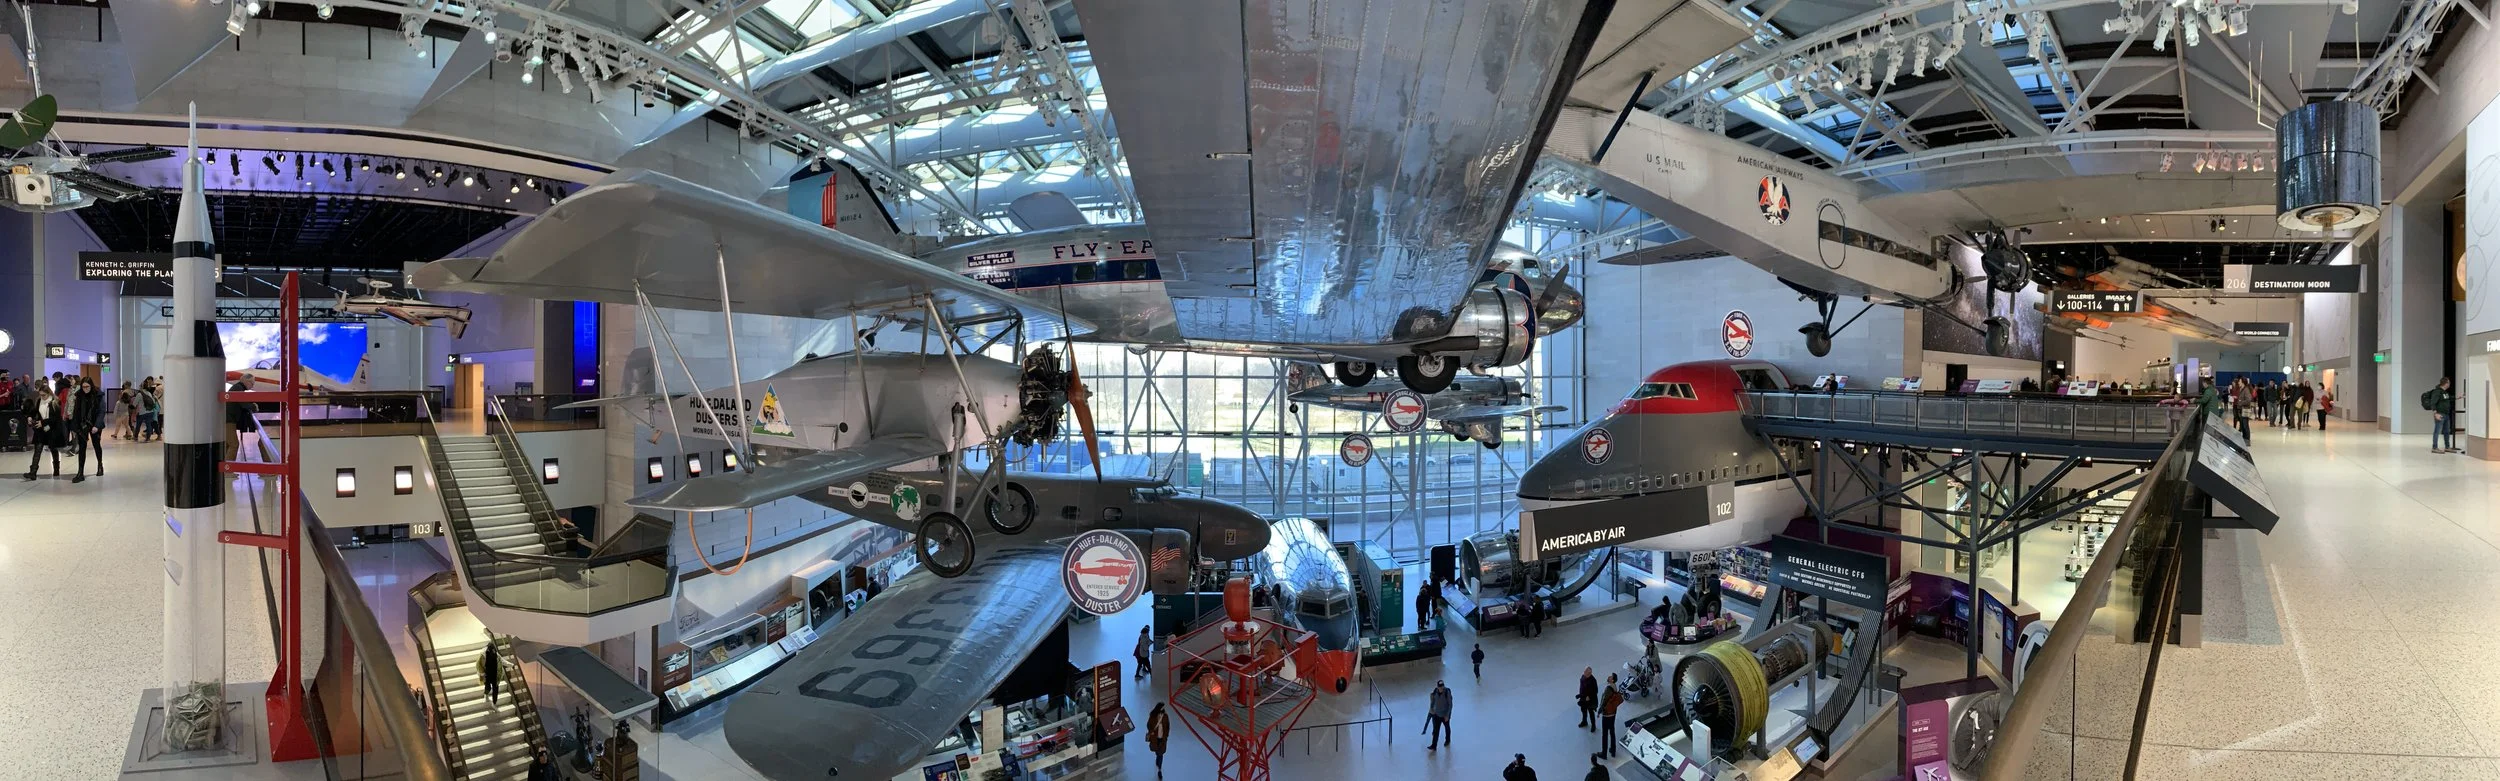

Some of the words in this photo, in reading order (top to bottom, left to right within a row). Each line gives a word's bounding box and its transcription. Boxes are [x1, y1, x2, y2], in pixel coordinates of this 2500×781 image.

[1664, 157, 1686, 170] MAIL
[1737, 156, 1774, 171] AMERICAN
[1775, 167, 1804, 181] AIRWAYS
[969, 259, 991, 267] SILVER
[86, 269, 133, 277] EXPLORING
[2226, 278, 2247, 289] 206
[2254, 281, 2305, 289] DESTINATION
[2307, 281, 2331, 289] MOON
[2067, 301, 2103, 310] 100-114
[1716, 502, 1732, 516] 102
[413, 524, 431, 535] 103
[1077, 534, 1129, 552] HUFF-DALAND
[1541, 532, 1593, 552] AMERICA
[1593, 529, 1608, 542] BY
[1608, 526, 1626, 539] AIR
[1692, 553, 1711, 563] 6601
[1787, 555, 1815, 568] GENERAL
[1818, 562, 1849, 576] ELECTRIC
[1852, 570, 1865, 579] CF6
[1084, 599, 1122, 613] DUSTER
